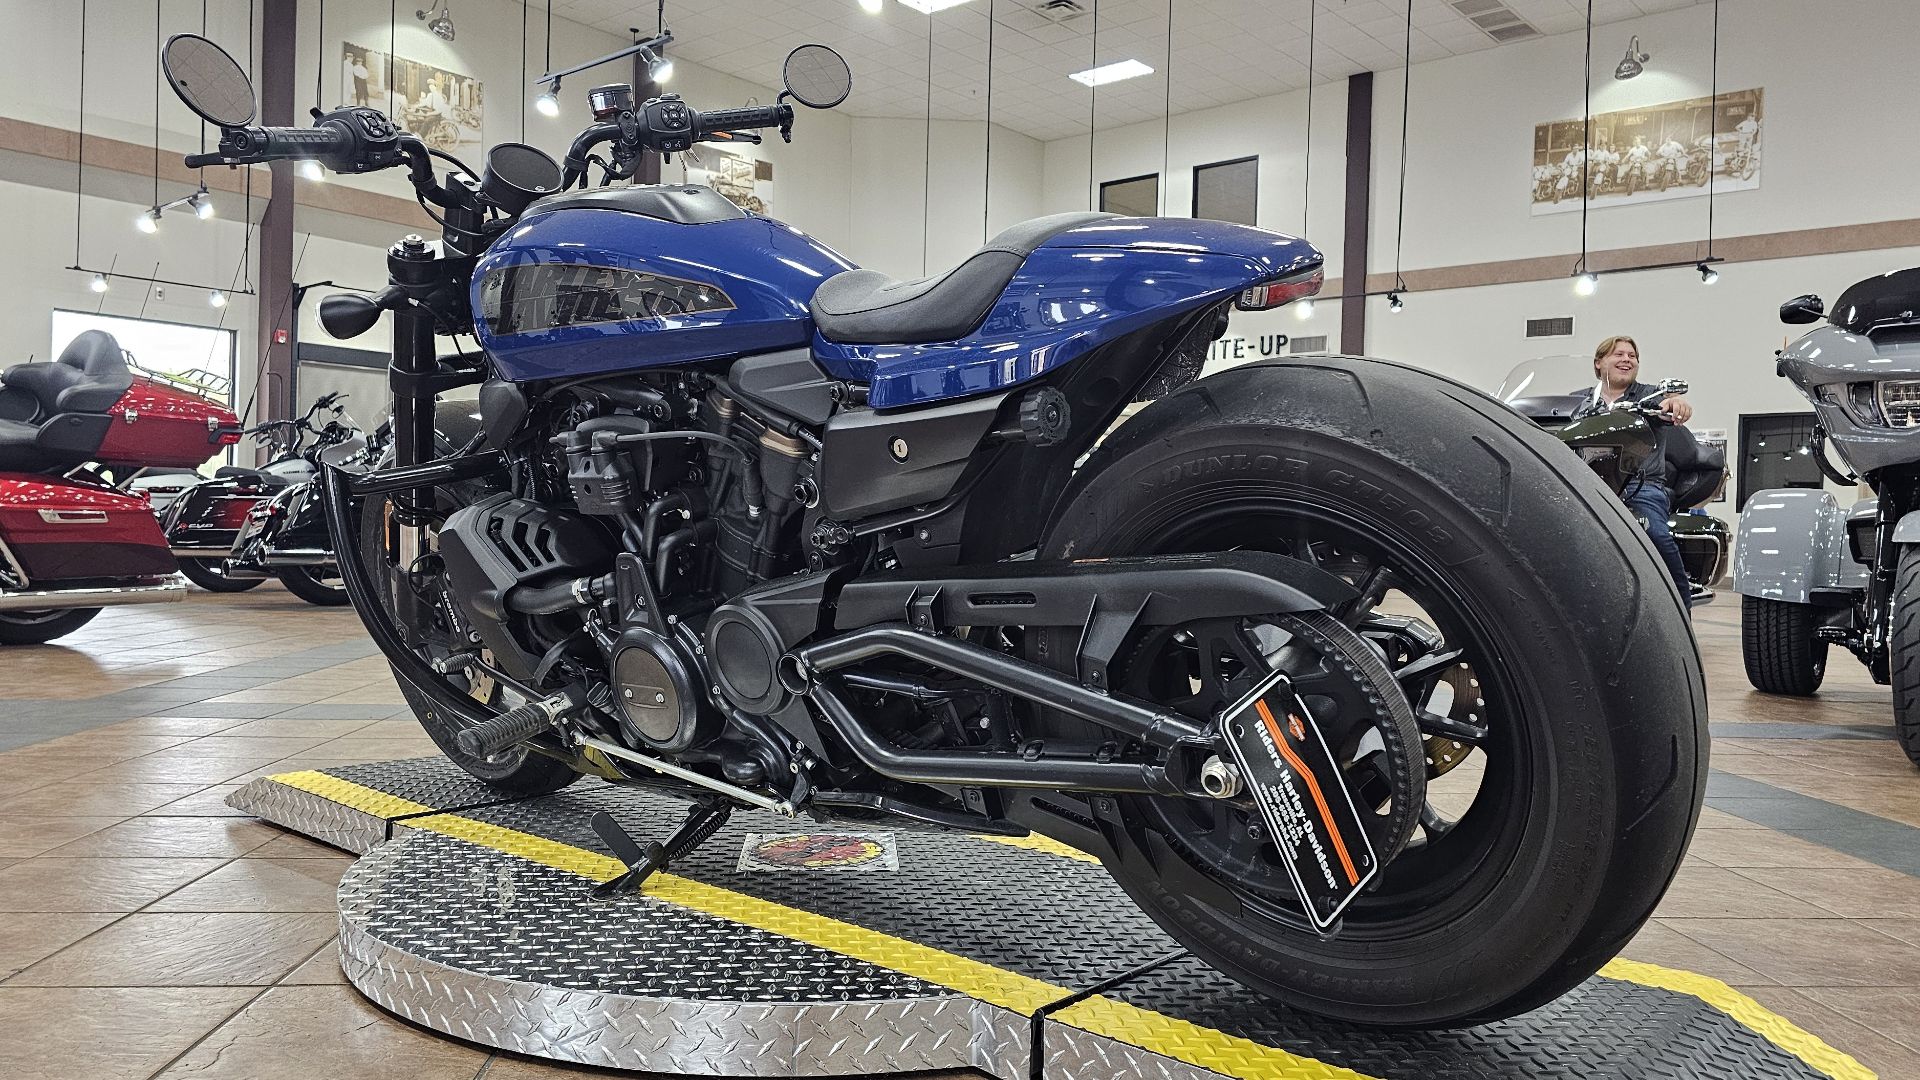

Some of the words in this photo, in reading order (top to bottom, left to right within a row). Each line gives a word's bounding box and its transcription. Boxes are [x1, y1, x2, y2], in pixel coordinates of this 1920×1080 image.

[1205, 334, 1289, 361] ITE-UP
[1164, 453, 1310, 487] DUNLOP
[442, 590, 461, 633] brembo
[1253, 719, 1284, 770] Riders
